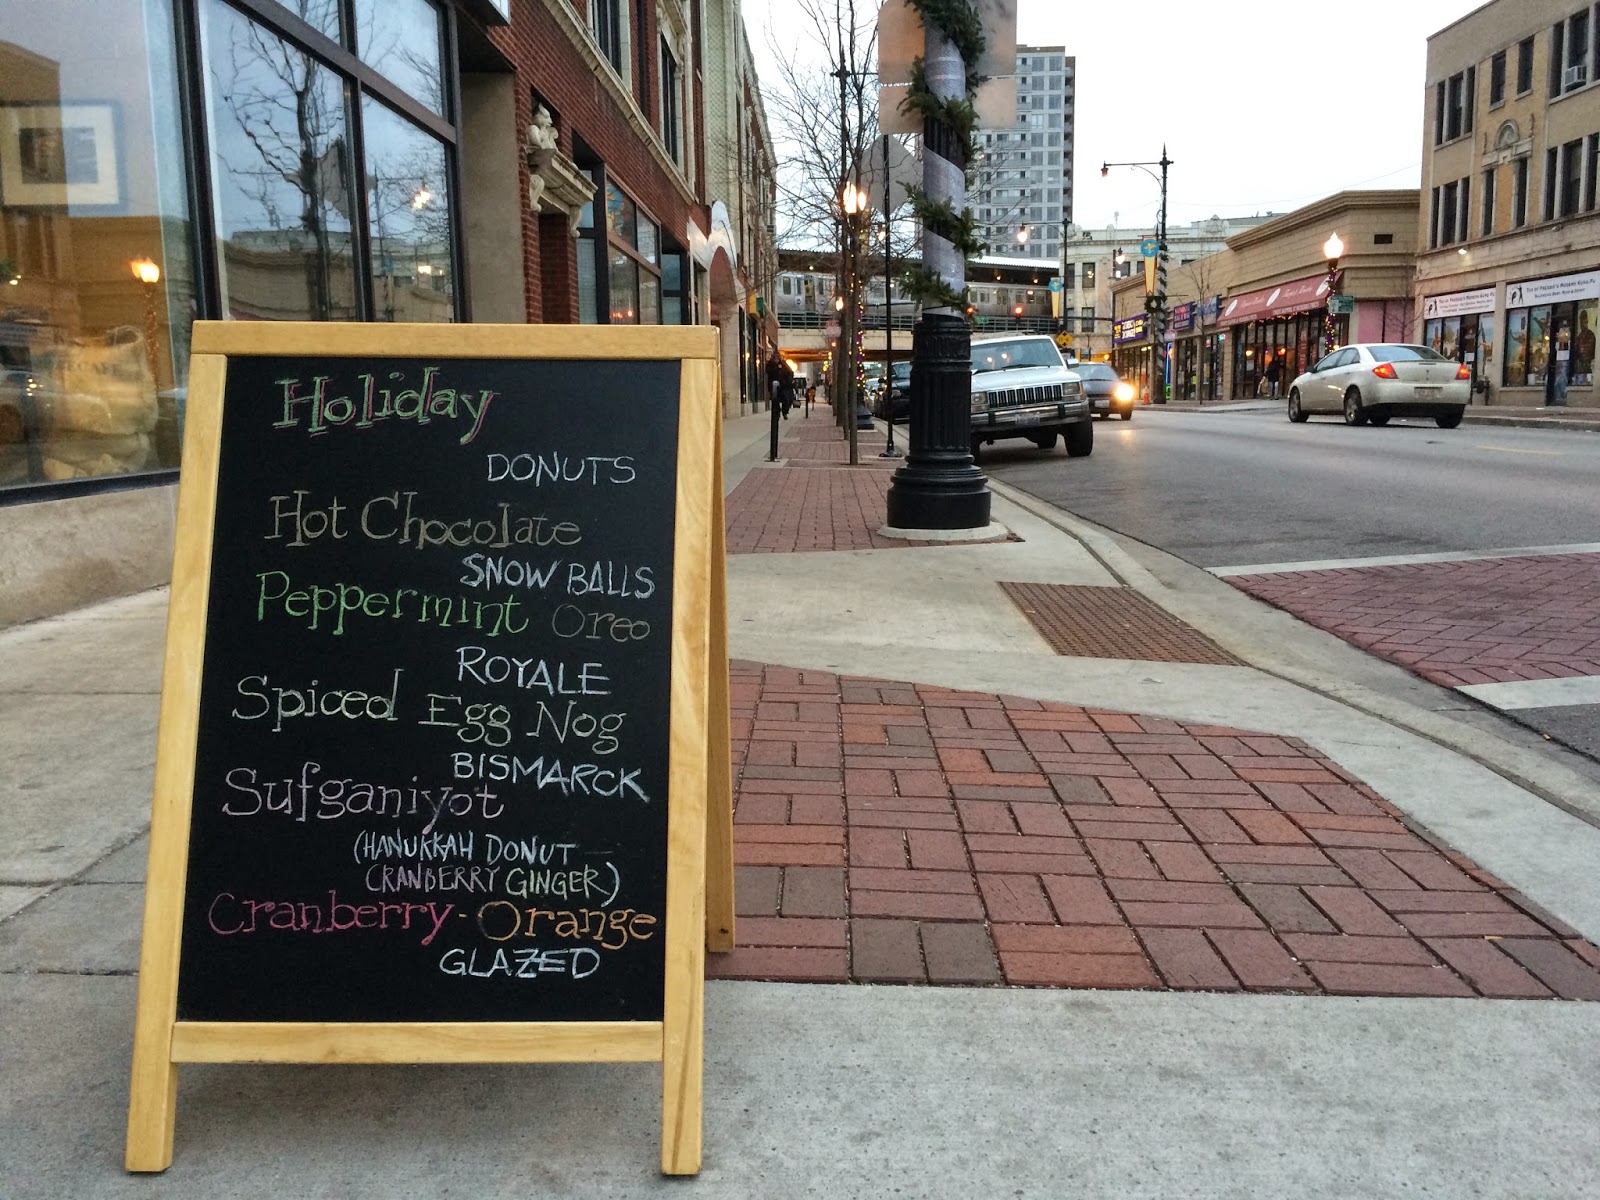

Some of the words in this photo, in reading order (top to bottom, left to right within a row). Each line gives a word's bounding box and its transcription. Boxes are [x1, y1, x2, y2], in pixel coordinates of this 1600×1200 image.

[273, 366, 500, 445] Holiday
[487, 452, 636, 487] DONUTS
[264, 490, 348, 547] Hot
[362, 491, 582, 550] Chocolate
[460, 553, 559, 591] SNOW
[567, 561, 655, 599] BALLS
[255, 571, 529, 637] Peppermint
[552, 604, 651, 642] Oreo
[456, 646, 611, 695] ROYALE
[232, 668, 404, 732] Spiced
[418, 693, 512, 747] Egg
[526, 700, 626, 754] Nog
[221, 762, 504, 834] Sufganiyot
[451, 752, 650, 802] BISMARCK
[485, 833, 578, 865] DONUT
[505, 862, 621, 907] GINGER)
[478, 900, 658, 950] Orange
[439, 948, 600, 978] GLAZED
